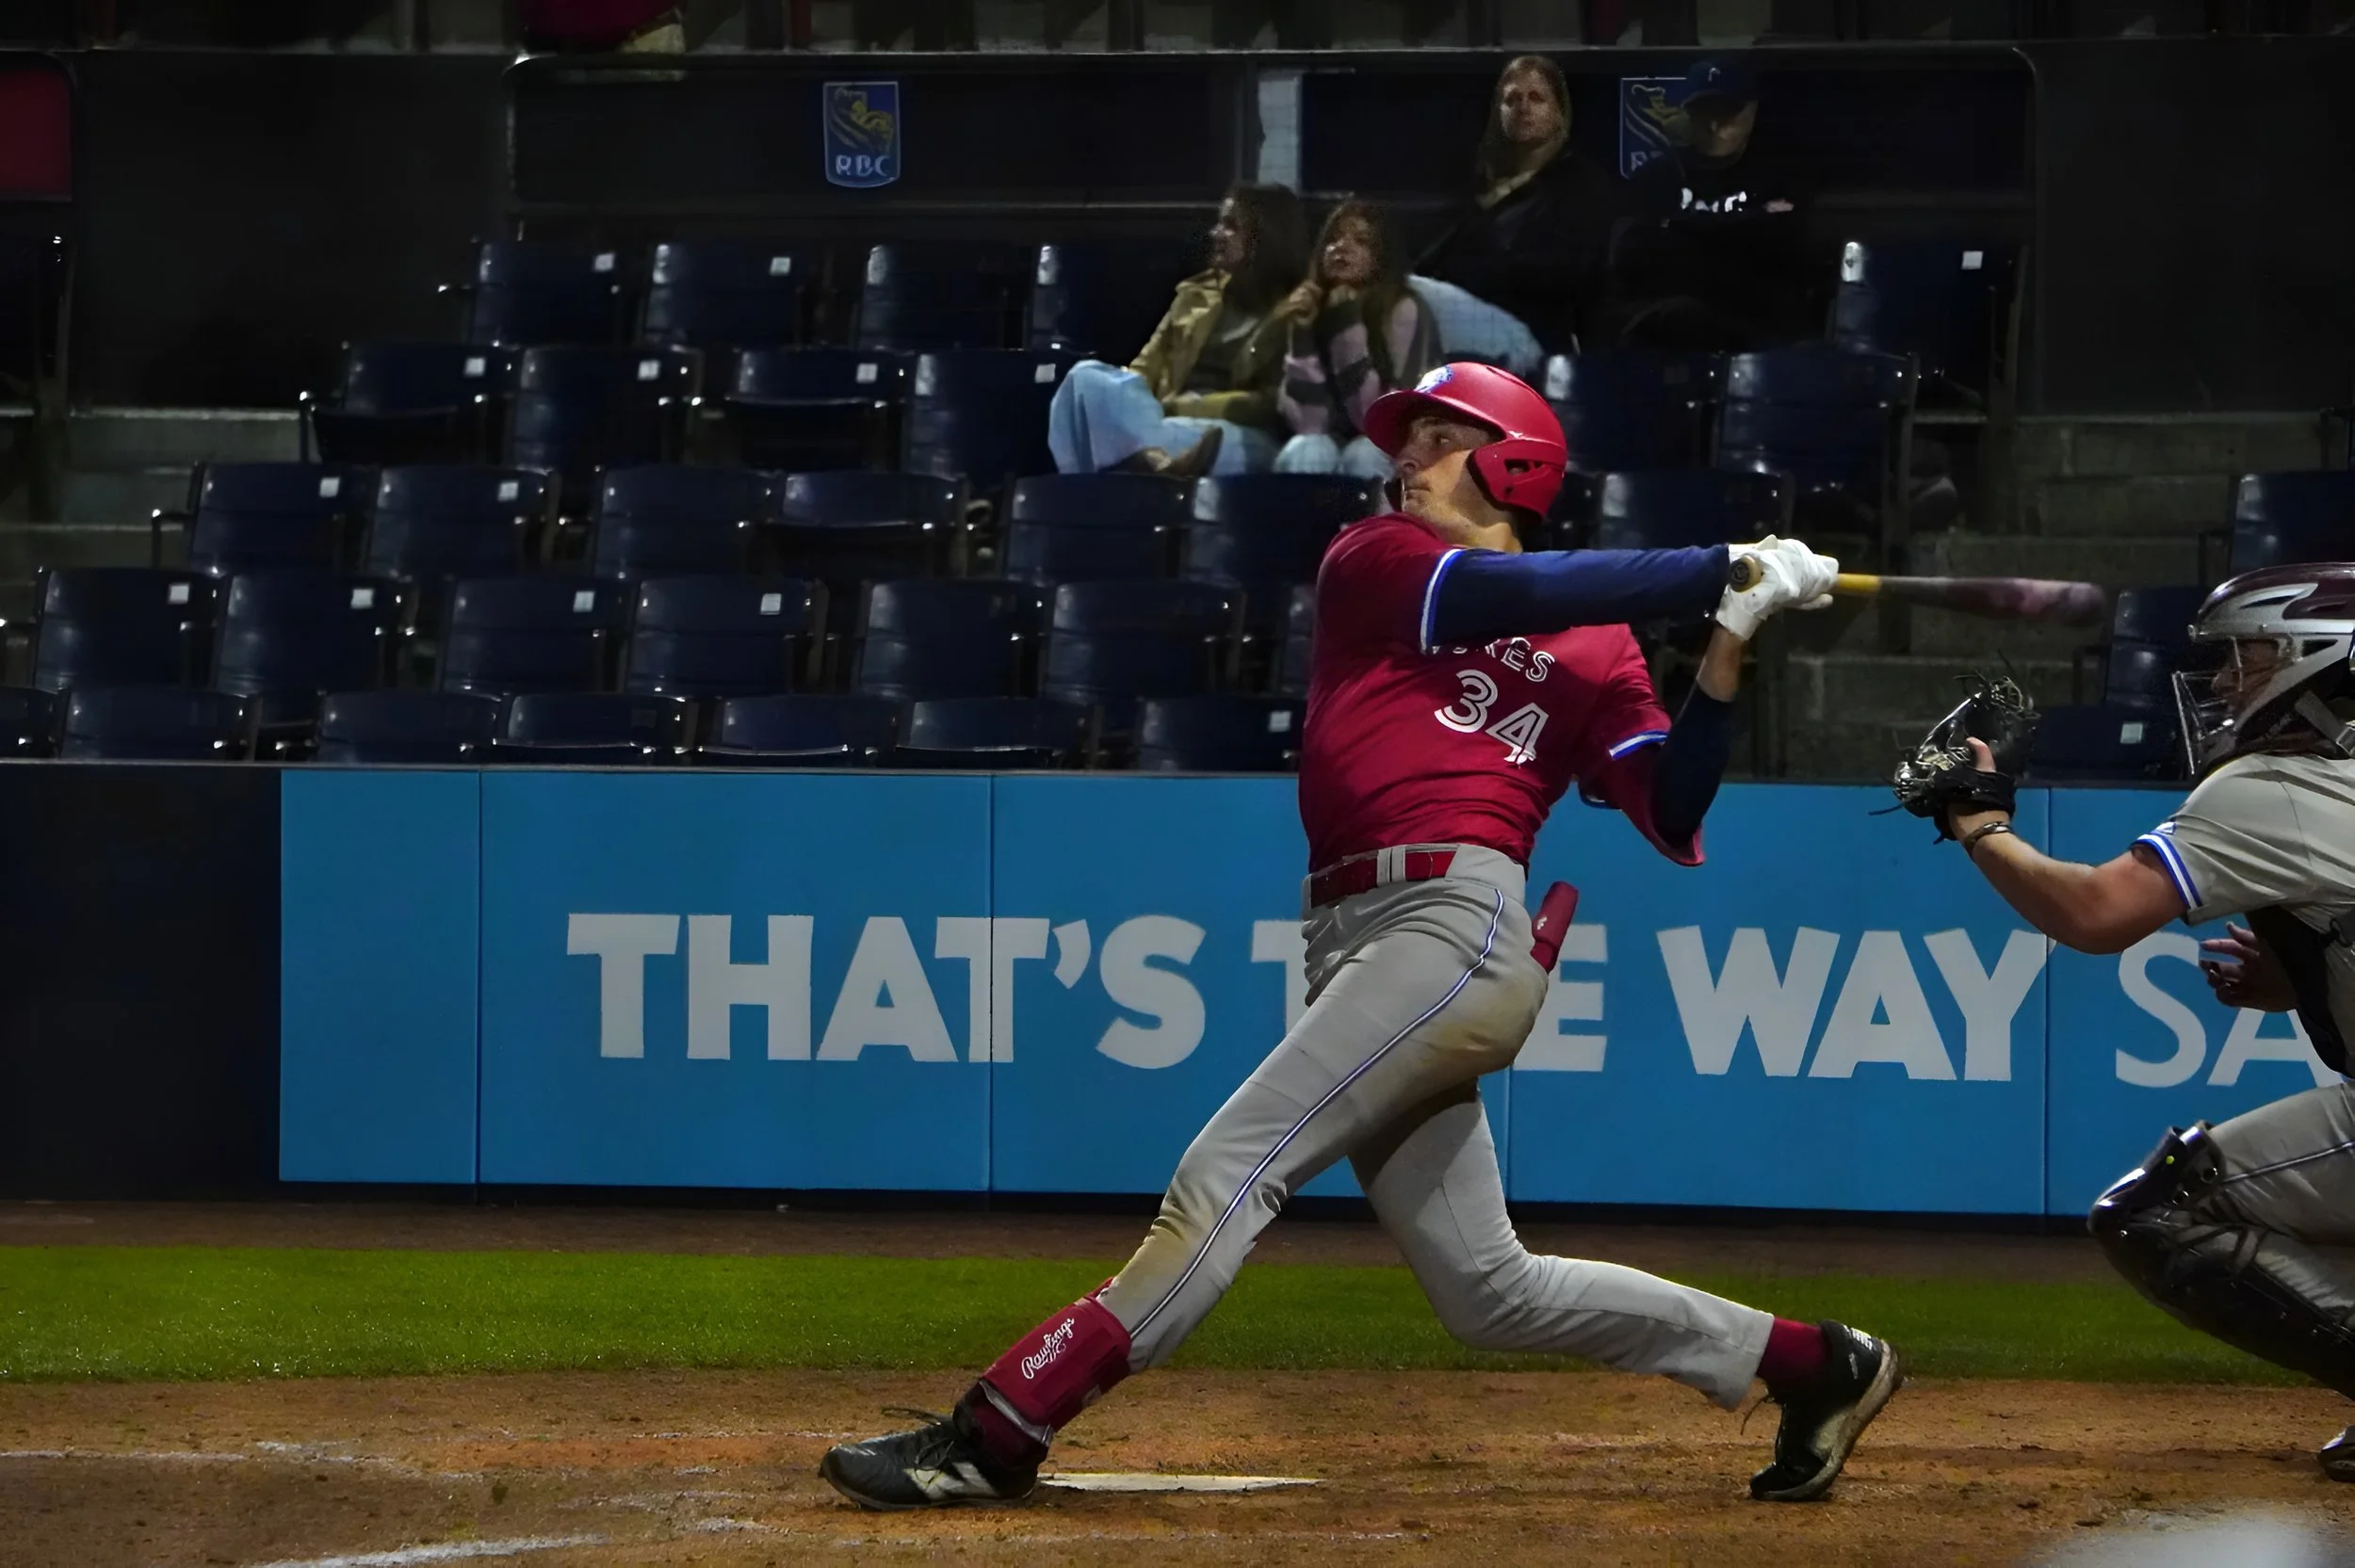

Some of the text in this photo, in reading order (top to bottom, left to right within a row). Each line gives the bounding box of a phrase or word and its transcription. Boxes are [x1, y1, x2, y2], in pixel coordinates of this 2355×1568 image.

[835, 154, 891, 177] RBC
[1434, 669, 1550, 766] 34
[567, 913, 1207, 1070] THAT'S
[1655, 925, 2057, 1082] WAY
[1021, 1317, 1075, 1380] Rawlings
